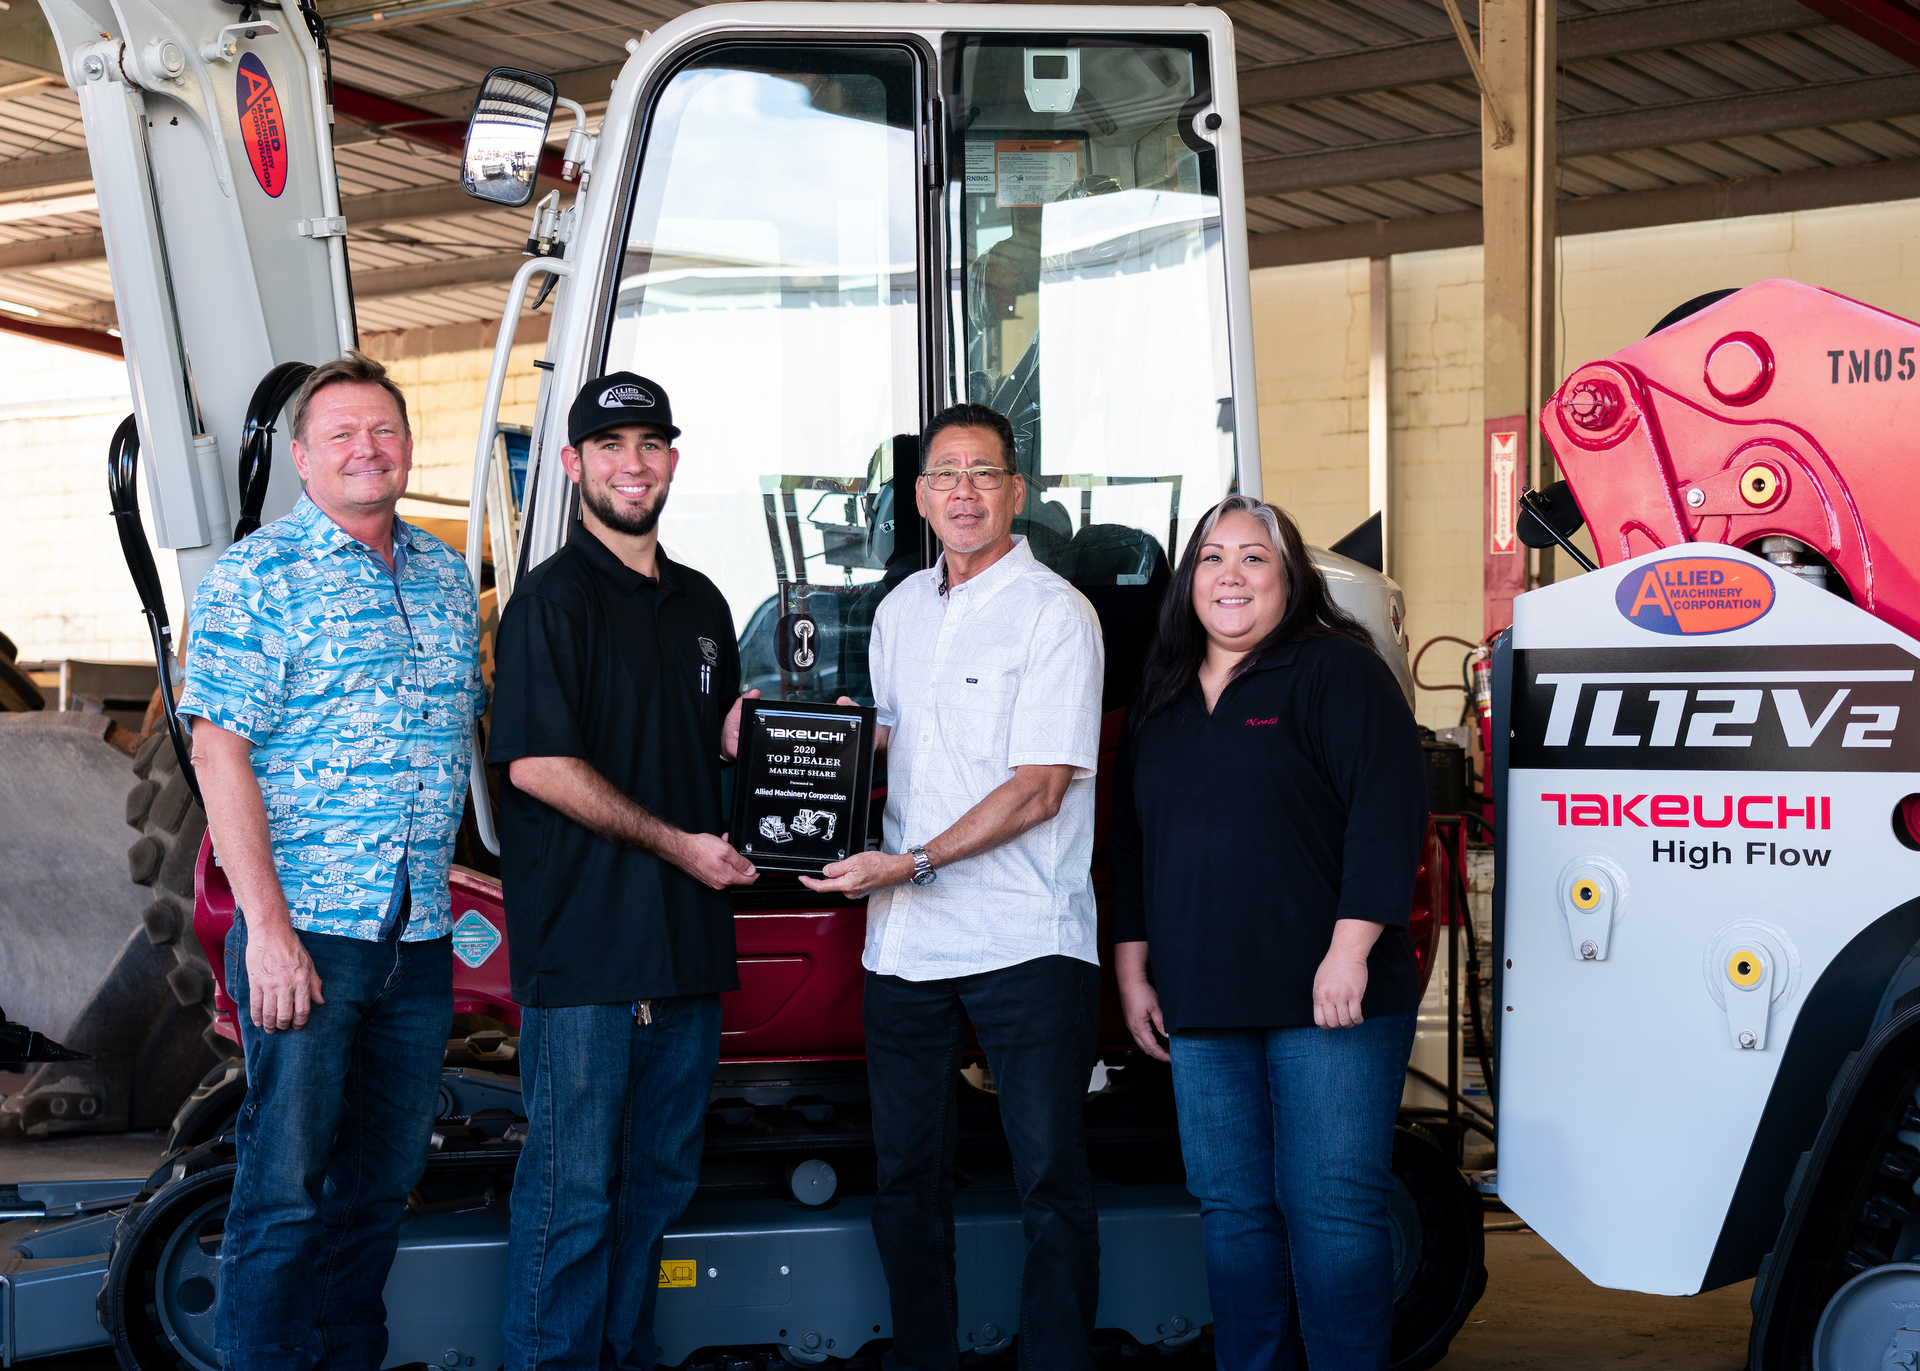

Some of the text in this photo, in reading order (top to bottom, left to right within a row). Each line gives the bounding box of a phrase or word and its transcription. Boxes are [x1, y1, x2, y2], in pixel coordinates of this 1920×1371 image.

[257, 103, 275, 170] MACHINERY
[251, 108, 272, 188] CORPORATION
[1827, 347, 1916, 384] TM05
[1495, 453, 1513, 462] FIRE
[1629, 570, 1724, 617] ALLIED
[1670, 588, 1743, 598] MACHINERY
[1673, 599, 1762, 611] CORPORATION
[1535, 669, 1915, 748] TL12V2
[766, 728, 845, 742] TAKEUCHI
[793, 745, 816, 754] 2020
[766, 754, 841, 767] TOP DEALER
[769, 767, 837, 778] MARKET SHARE
[754, 788, 847, 801] Allied Machinery Corporation
[1541, 793, 1831, 830] TAKEUCHI
[1652, 840, 1832, 869] High Flow
